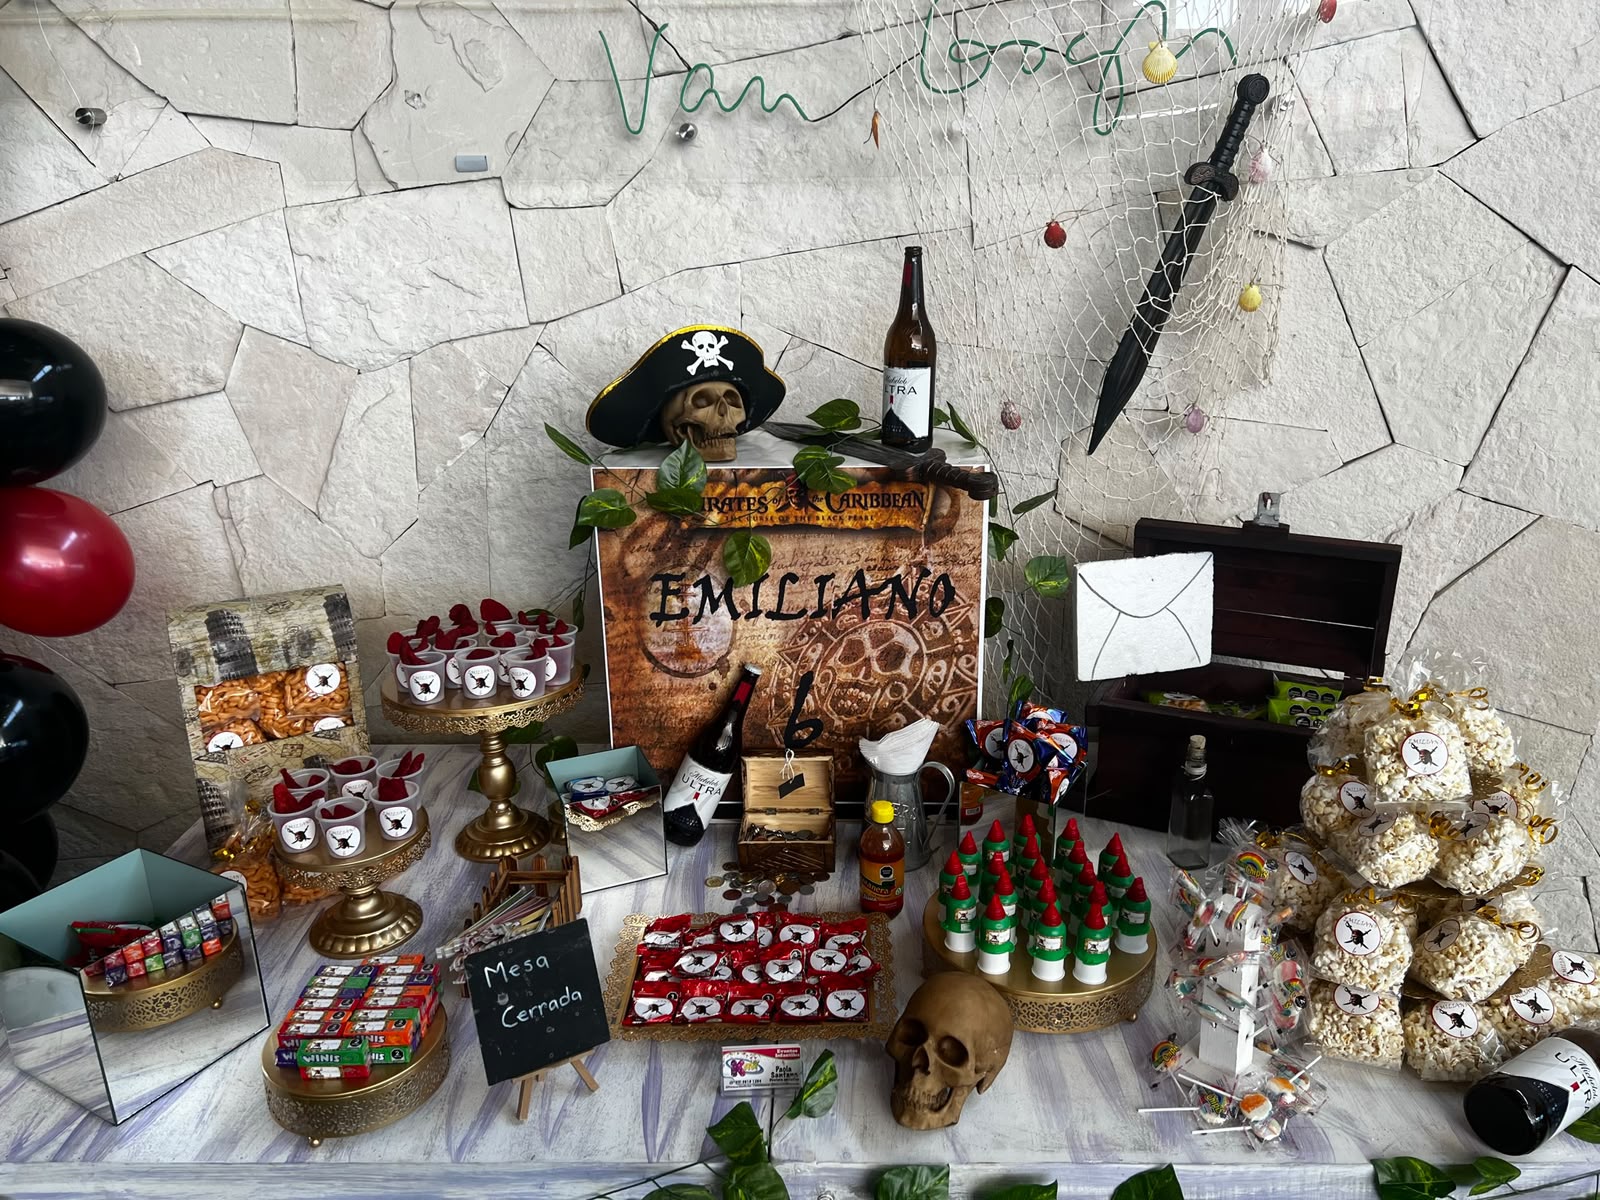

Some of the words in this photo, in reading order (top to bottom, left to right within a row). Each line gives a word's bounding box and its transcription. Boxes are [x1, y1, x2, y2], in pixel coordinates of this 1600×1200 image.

[598, 23, 809, 135] Van
[884, 384, 918, 395] LTRA
[701, 494, 769, 514] IRATES
[825, 489, 925, 514] CARIBBEAN
[814, 514, 844, 522] BLACK
[847, 514, 875, 522] PEARL
[649, 566, 956, 628] EMILIANO
[783, 671, 824, 749] 6
[681, 773, 721, 796] ULTRA
[483, 955, 550, 988] Mesa
[501, 986, 583, 1029] Cerrada
[302, 1053, 341, 1063] WINIS
